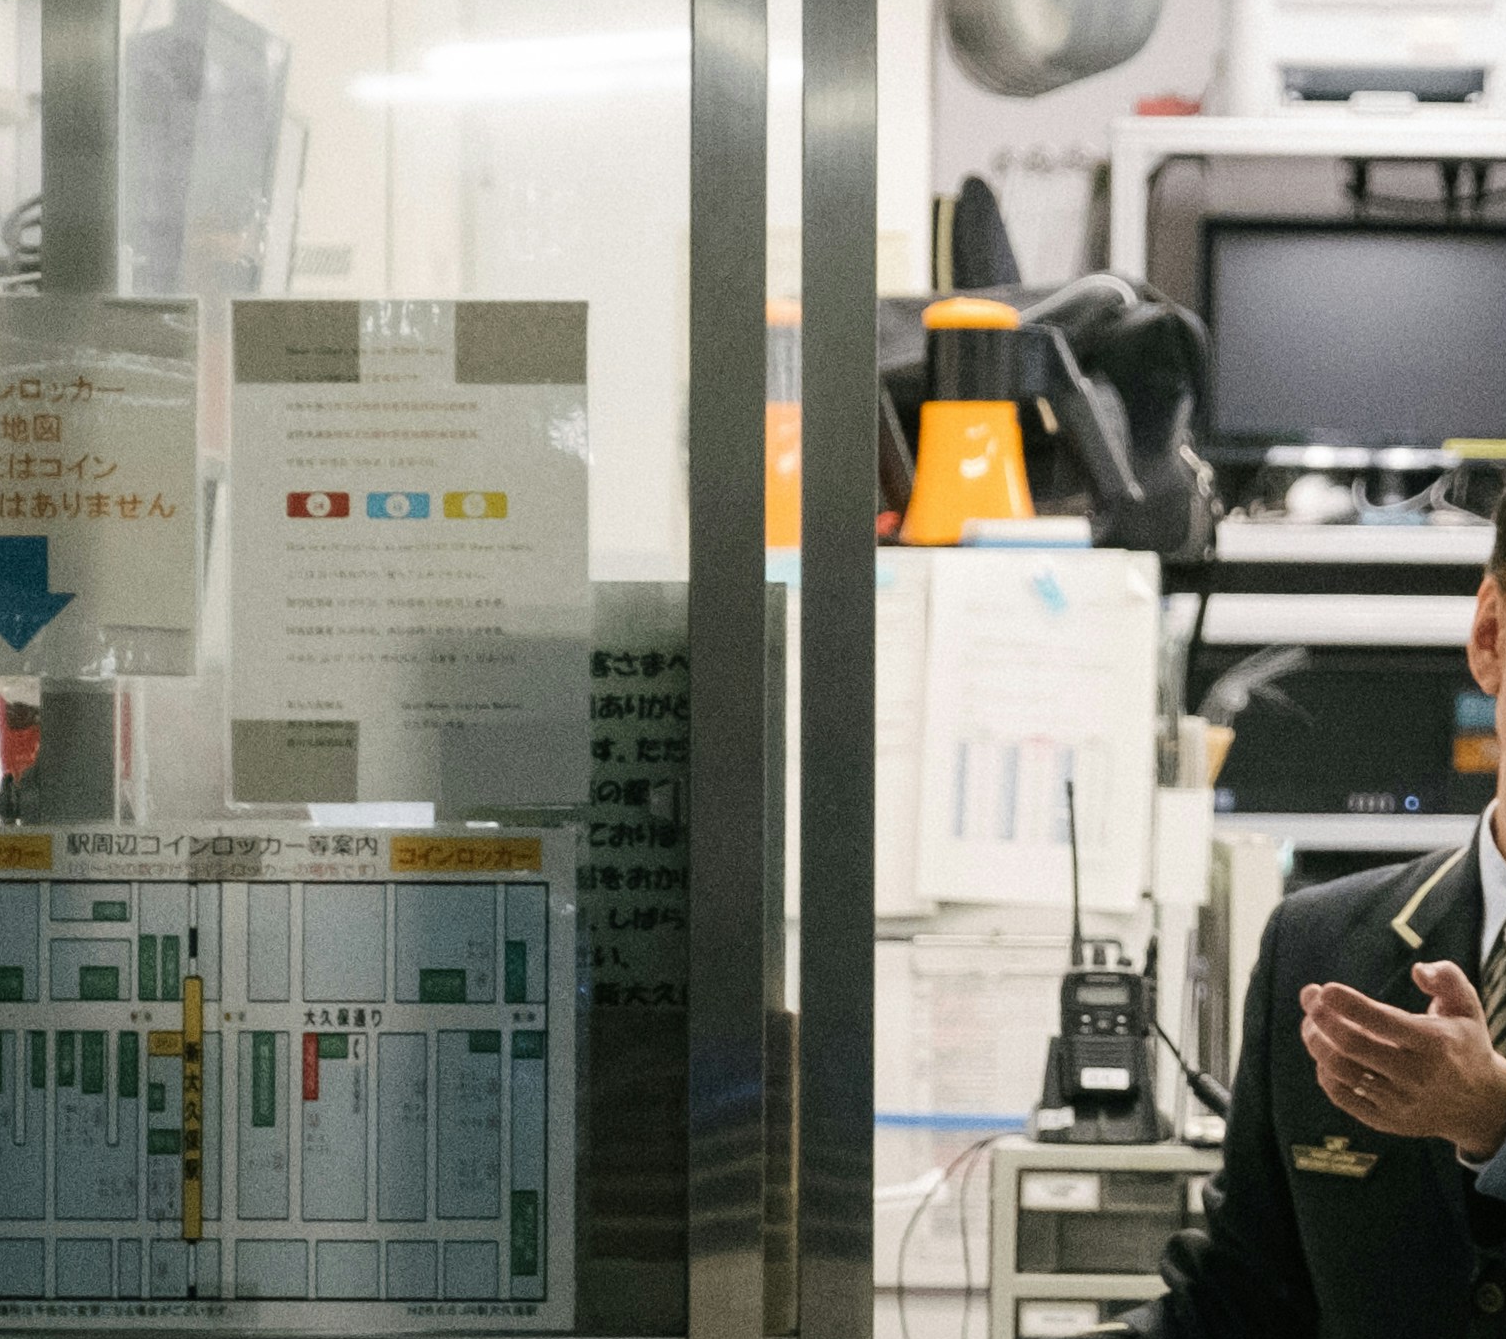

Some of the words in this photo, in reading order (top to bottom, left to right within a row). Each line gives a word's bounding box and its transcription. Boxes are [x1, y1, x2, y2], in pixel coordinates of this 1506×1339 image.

[0, 414, 61, 443] 地図
[66, 833, 378, 857] 駅周辺コインロッカー等案内
